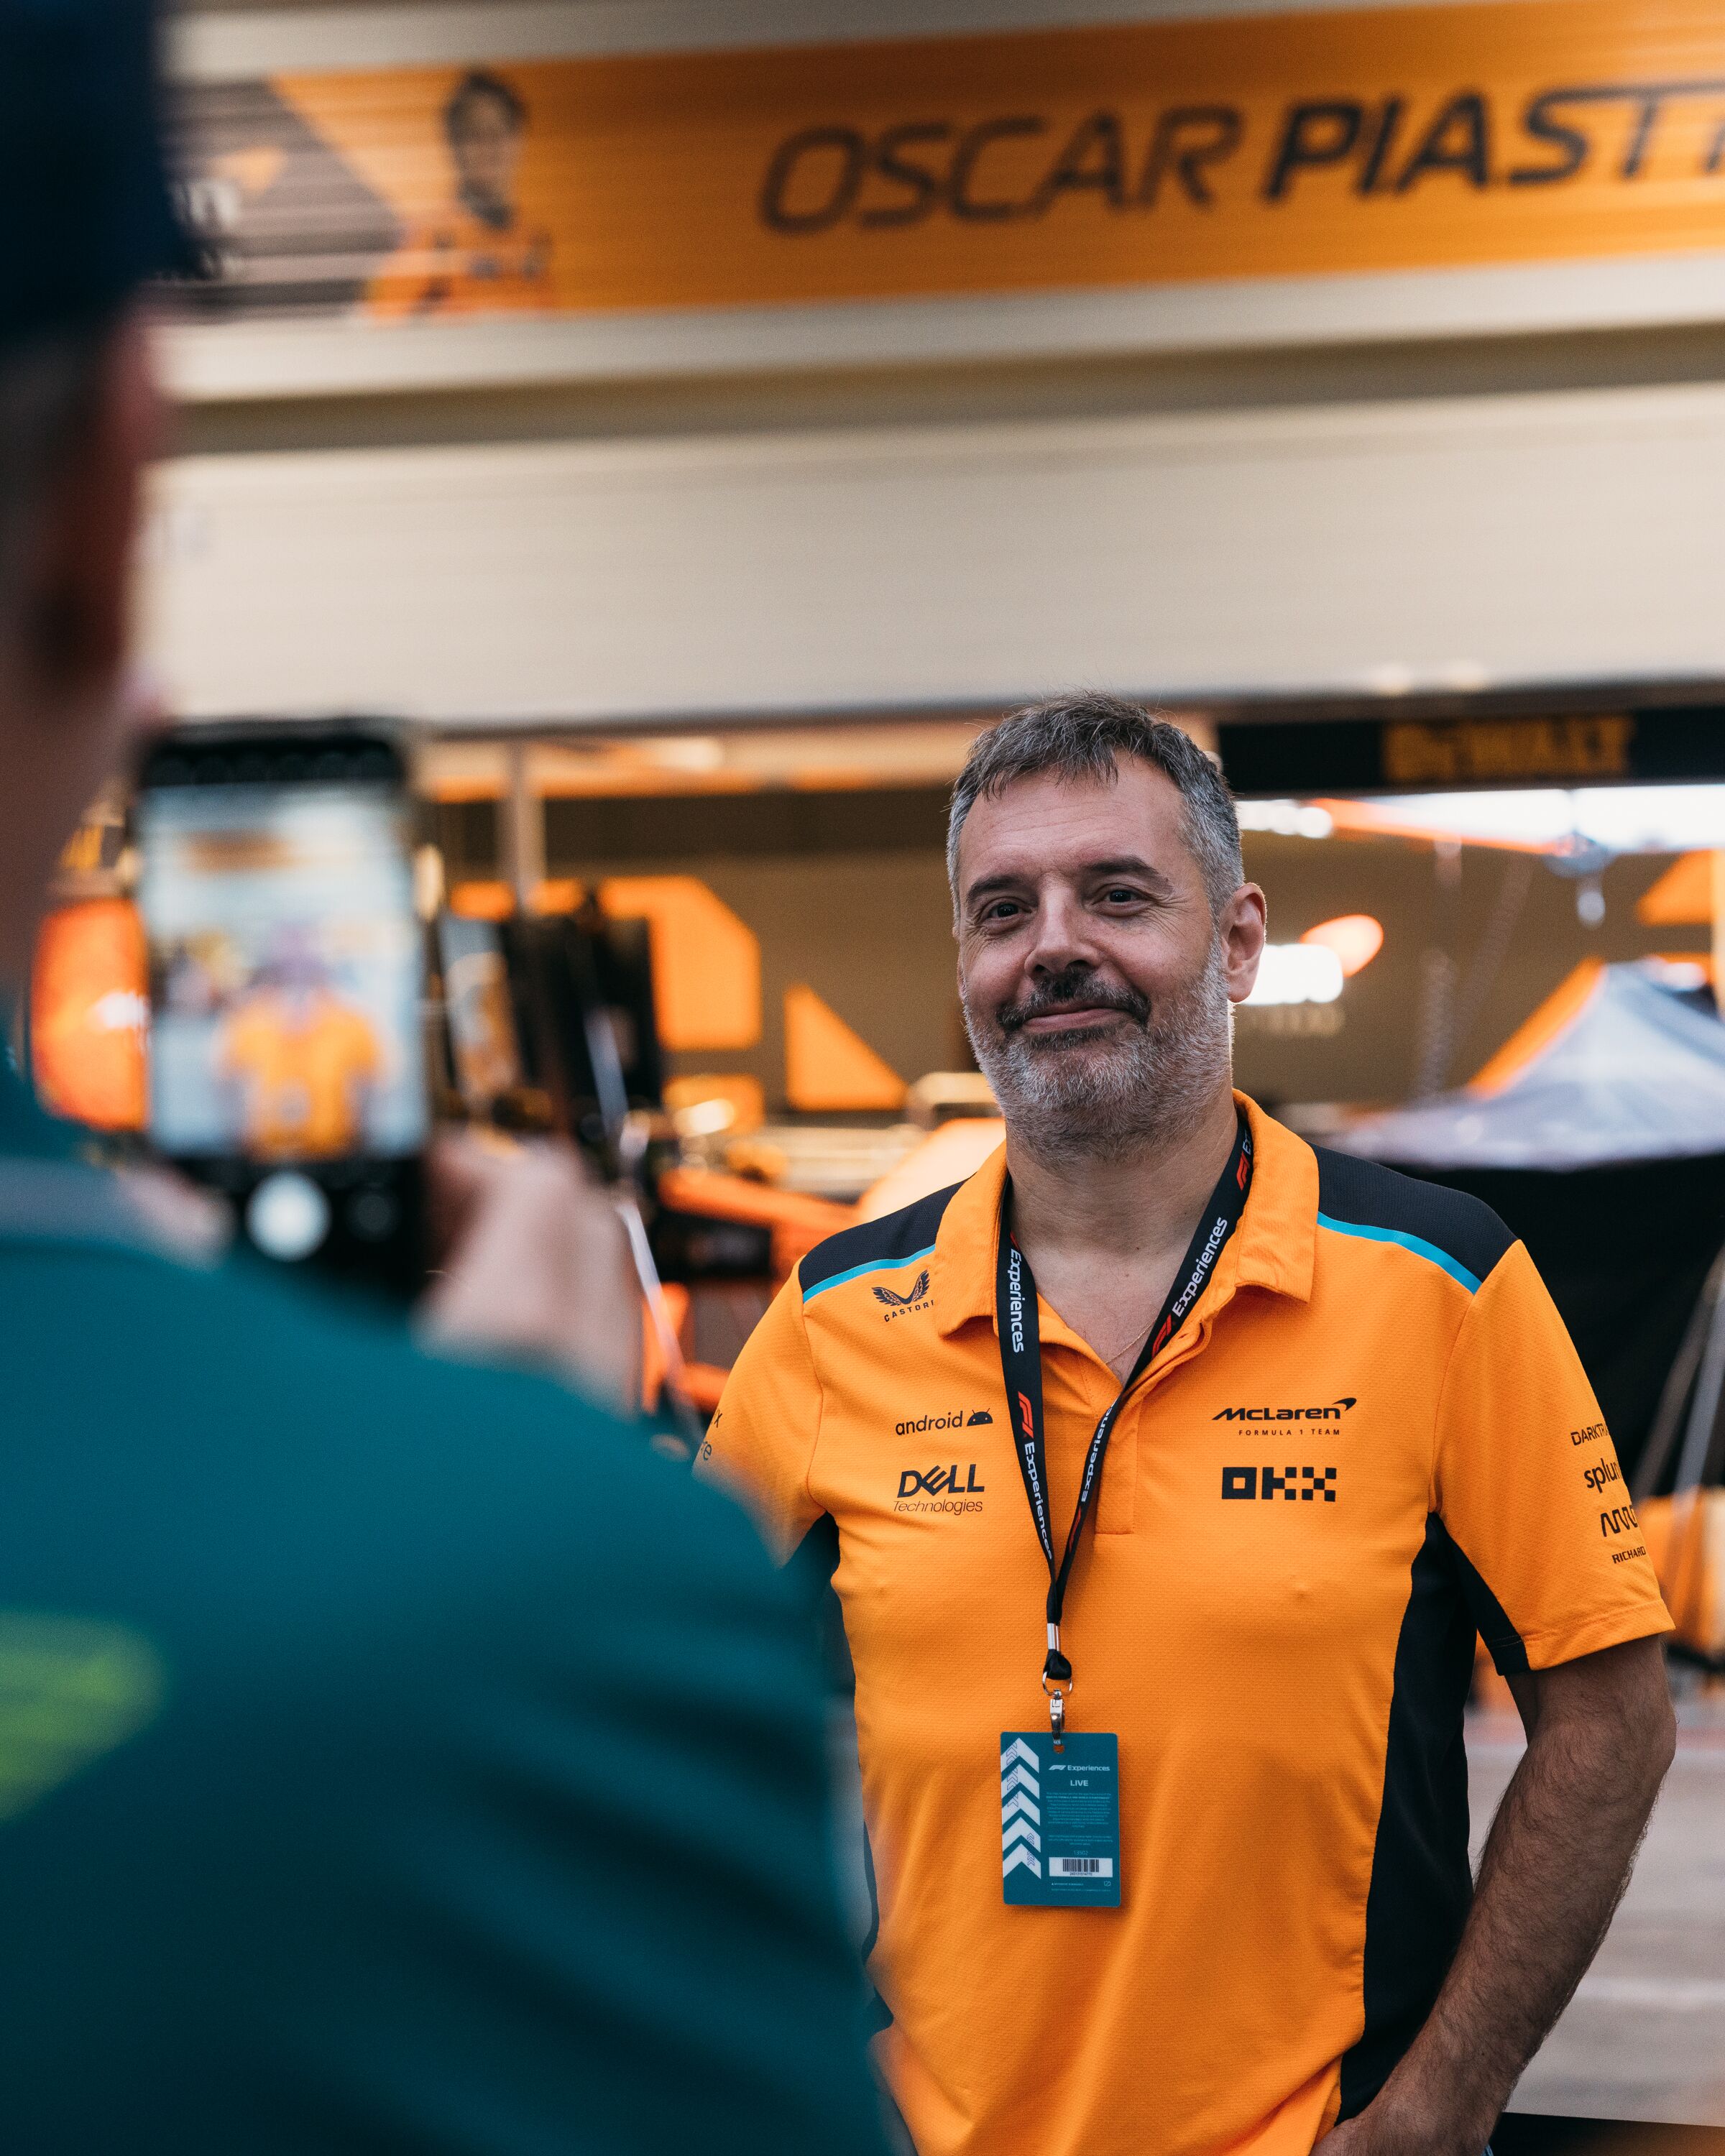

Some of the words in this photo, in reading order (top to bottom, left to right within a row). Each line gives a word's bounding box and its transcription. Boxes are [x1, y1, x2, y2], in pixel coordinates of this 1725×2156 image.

[760, 105, 1243, 234] OSCAR
[1172, 1217, 1227, 1317] Experiences
[1008, 1248, 1026, 1353] Experiences
[896, 1411, 963, 1435] android
[1212, 1407, 1340, 1421] McLaren
[897, 1464, 985, 1498] DELL
[1222, 1467, 1337, 1502] OKX
[893, 1498, 983, 1516] Technologies
[1611, 1546, 1646, 1564] RICHARD
